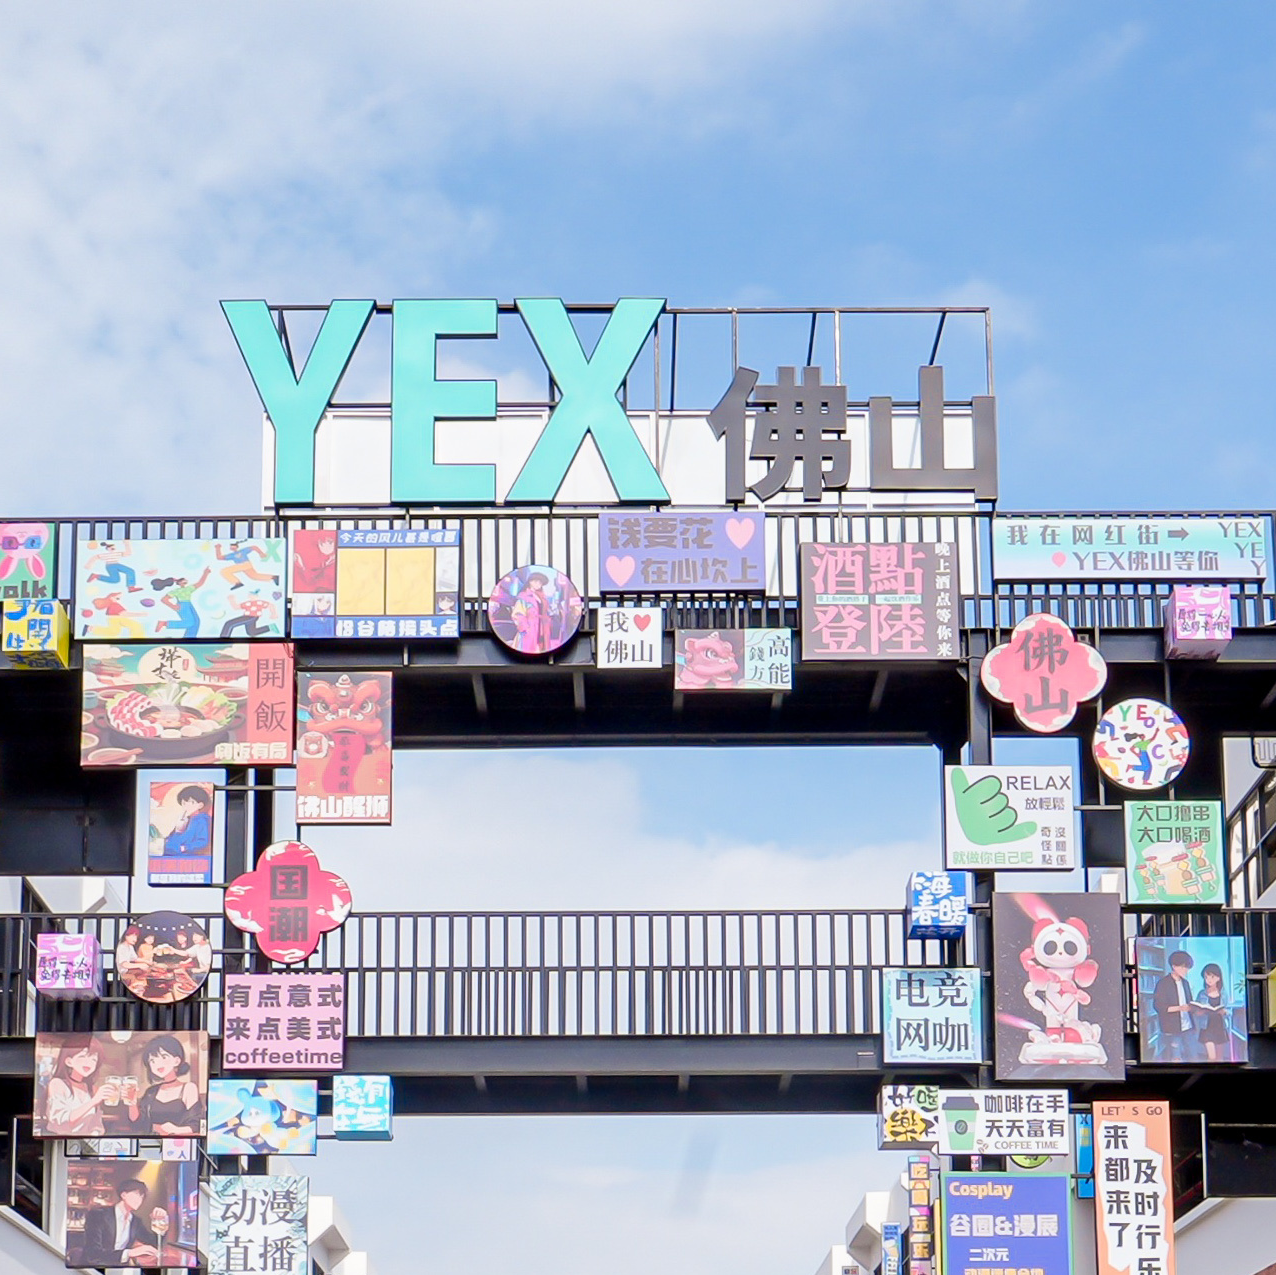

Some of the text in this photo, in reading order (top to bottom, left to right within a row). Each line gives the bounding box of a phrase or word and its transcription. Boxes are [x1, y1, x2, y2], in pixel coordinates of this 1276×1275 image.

[220, 298, 998, 505] YEX 佛山
[607, 517, 713, 549] 钱要花
[1007, 524, 1160, 546] 我在网红街
[1219, 521, 1262, 538] YEX
[1072, 550, 1219, 572] YEX佛山等你
[1235, 542, 1264, 559] YE
[641, 556, 758, 584] 在心坎上
[811, 543, 926, 595] 酒點
[605, 611, 629, 633] 我
[811, 604, 928, 655] 登陸
[604, 639, 654, 664] 佛山
[768, 635, 791, 685] 高能
[1015, 628, 1069, 715] 佛山
[253, 658, 287, 733] 開飯
[1006, 775, 1071, 792] RELAX
[1025, 796, 1066, 811] 放輕鬆
[1136, 805, 1211, 823] 大口撸串
[1136, 826, 1211, 844] 大口喝酒
[952, 850, 1034, 866] 就做你自己吧
[268, 865, 308, 942] 国潮
[227, 983, 343, 1009] 有点意式
[895, 972, 967, 1008] 电竞
[226, 1016, 343, 1041] 来点美式
[895, 1016, 969, 1053] 网咖
[225, 1048, 343, 1065] coffeetime
[984, 1094, 1065, 1113] 咖啡在手
[1145, 1105, 1163, 1116] GO
[985, 1118, 1065, 1138] 天天富有
[994, 1140, 1060, 1150] COFFEE TIME
[949, 1181, 1014, 1200] Cosplay
[1104, 1124, 1131, 1248] 来都来了
[220, 1188, 296, 1225] 动漫
[225, 1235, 297, 1272] 直播
[968, 1247, 1009, 1262] 二次元
